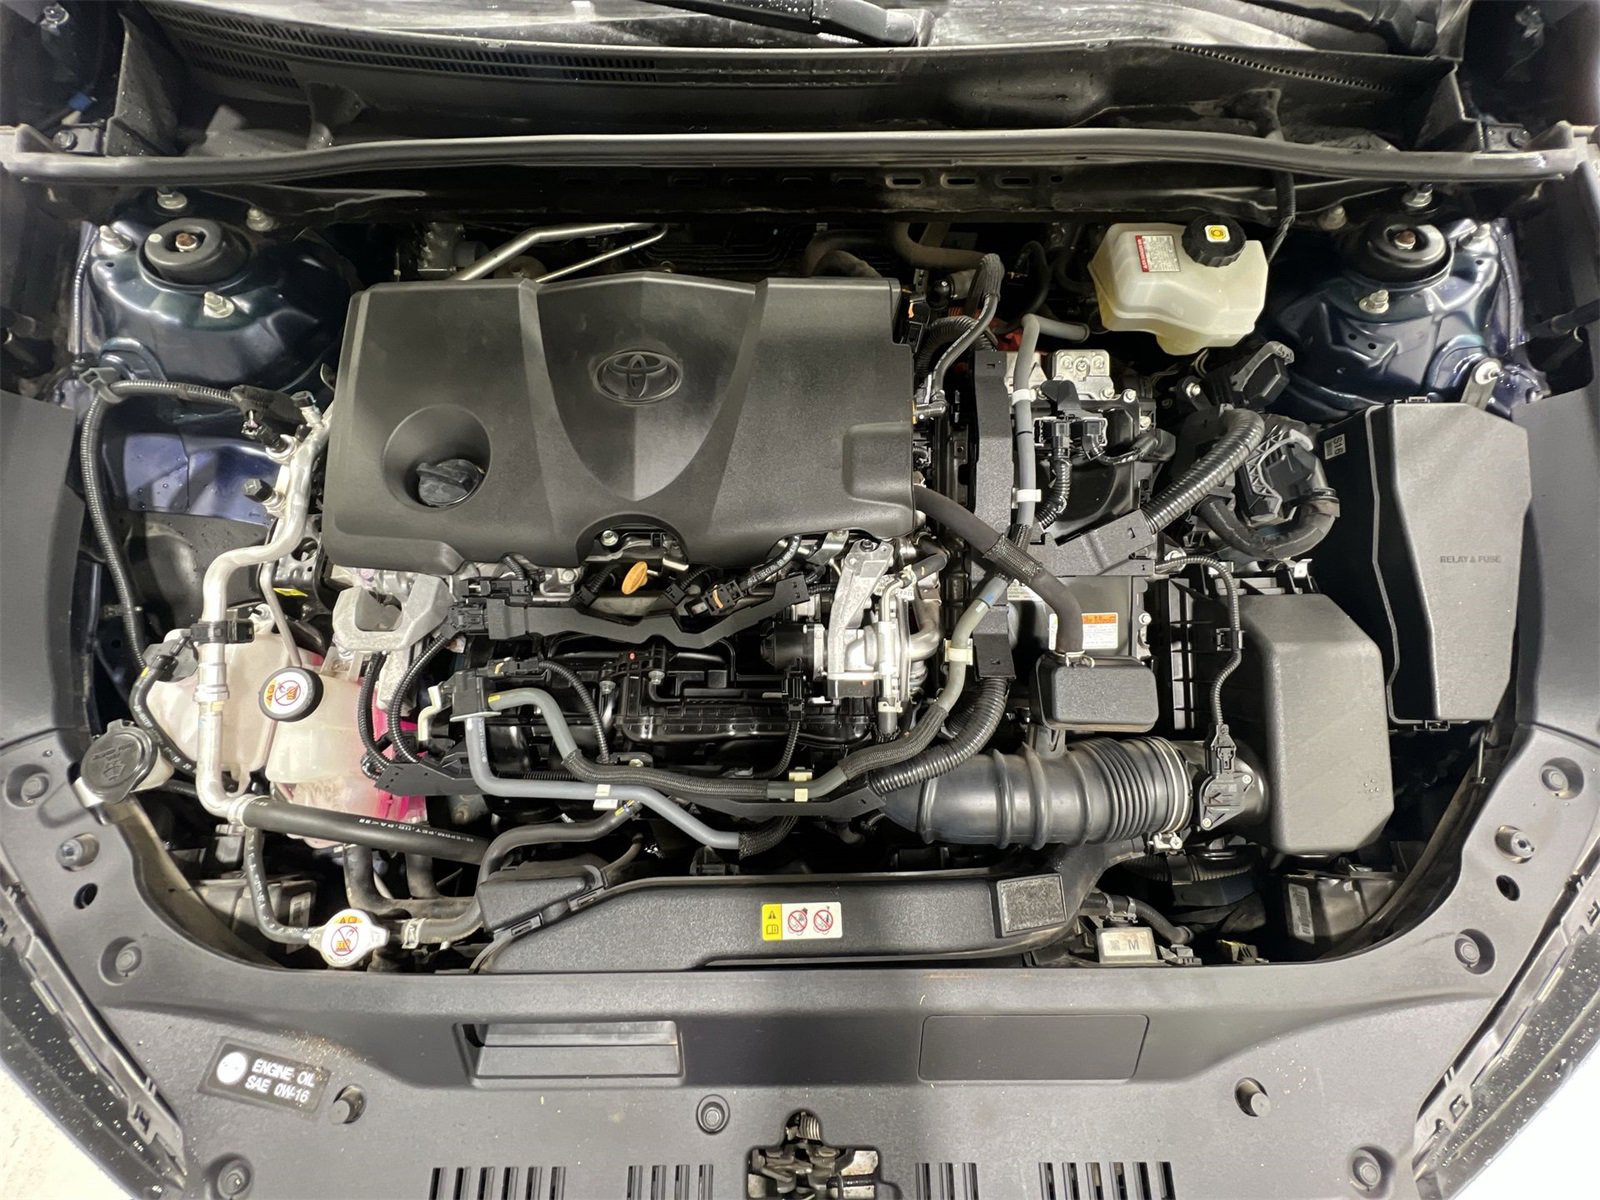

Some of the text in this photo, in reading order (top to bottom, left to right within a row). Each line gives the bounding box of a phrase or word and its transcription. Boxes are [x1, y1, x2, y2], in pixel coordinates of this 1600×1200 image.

[1440, 555, 1468, 563] RELAY
[1478, 555, 1502, 563] FUSE
[1127, 938, 1140, 951] M
[252, 1058, 316, 1088] ENGINE OIL
[244, 1074, 310, 1103] SAE 0W-16
